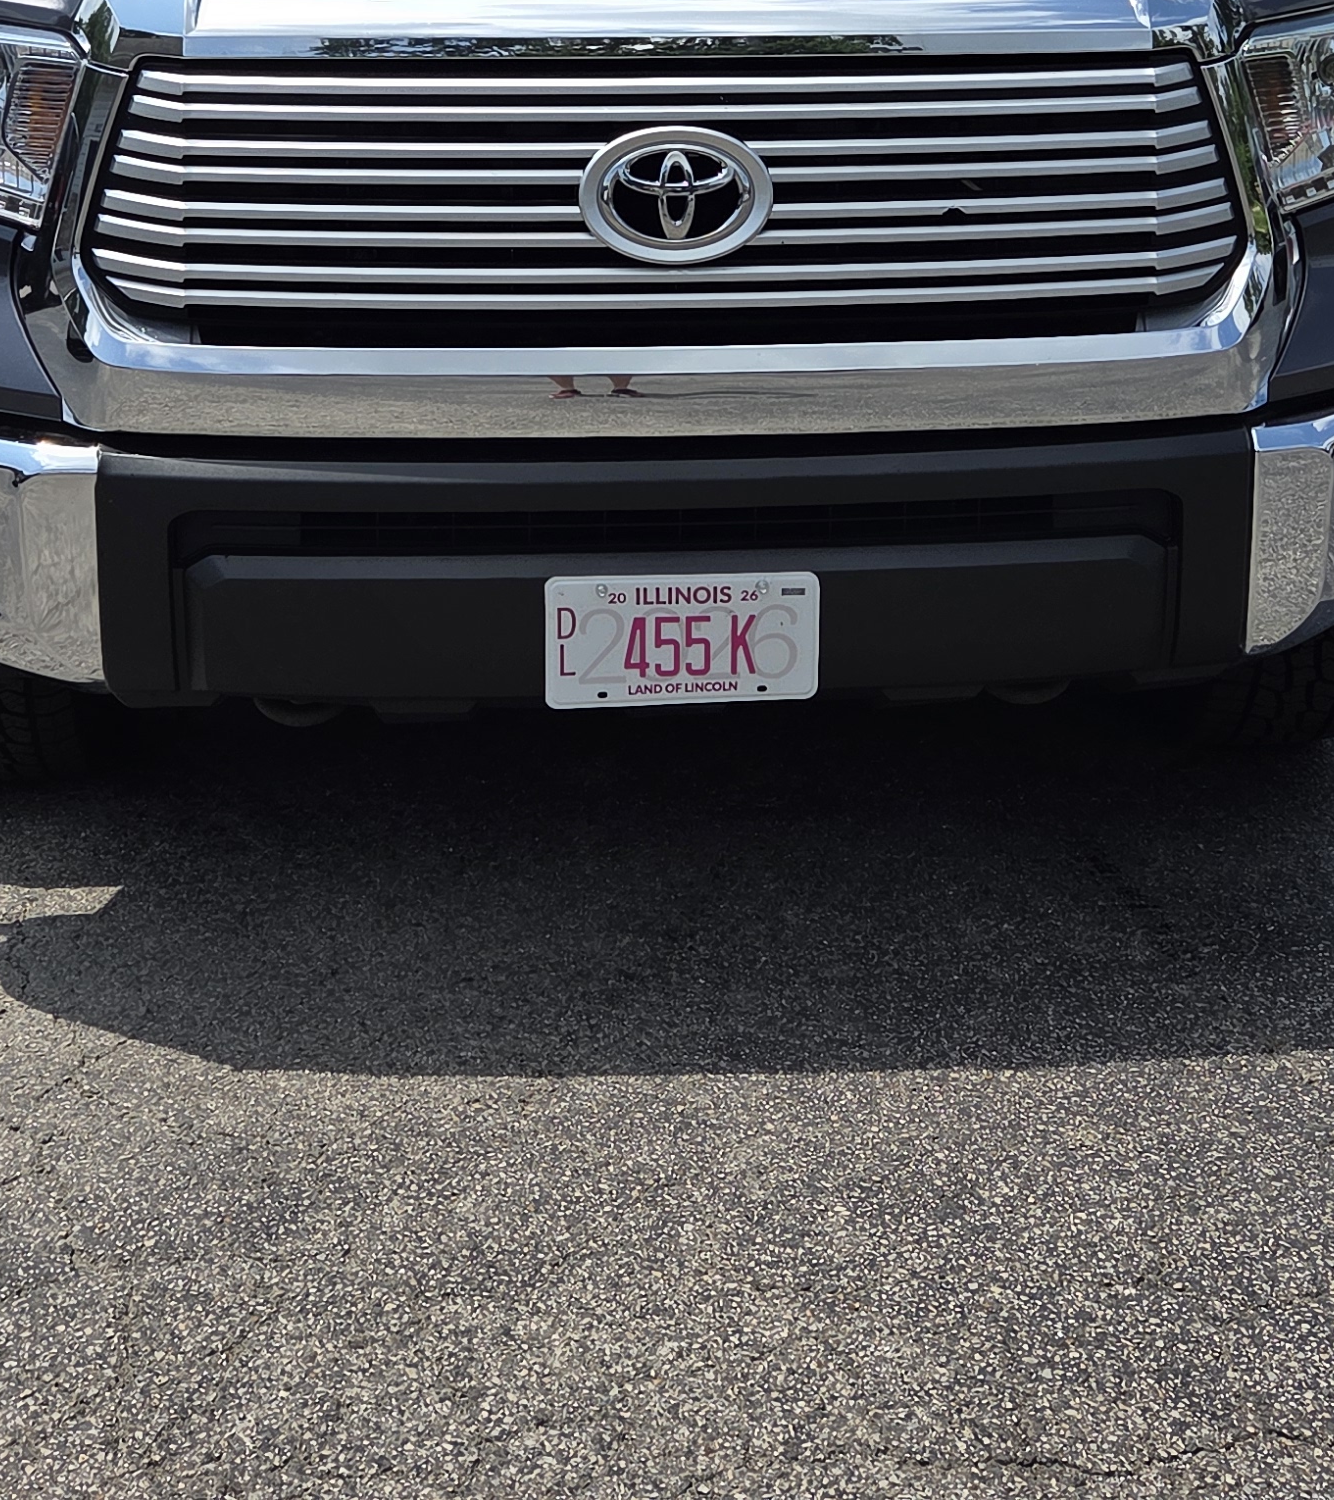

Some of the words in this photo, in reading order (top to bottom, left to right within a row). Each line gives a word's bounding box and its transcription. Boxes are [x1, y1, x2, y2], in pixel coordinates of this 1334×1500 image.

[608, 592, 627, 604] 20
[635, 586, 732, 606] ILLINOIS
[740, 589, 758, 602] 26
[624, 615, 711, 678] 455
[730, 614, 756, 675] K
[628, 684, 663, 696] LAND
[665, 683, 682, 694] OF
[684, 681, 738, 693] LINCOLN
